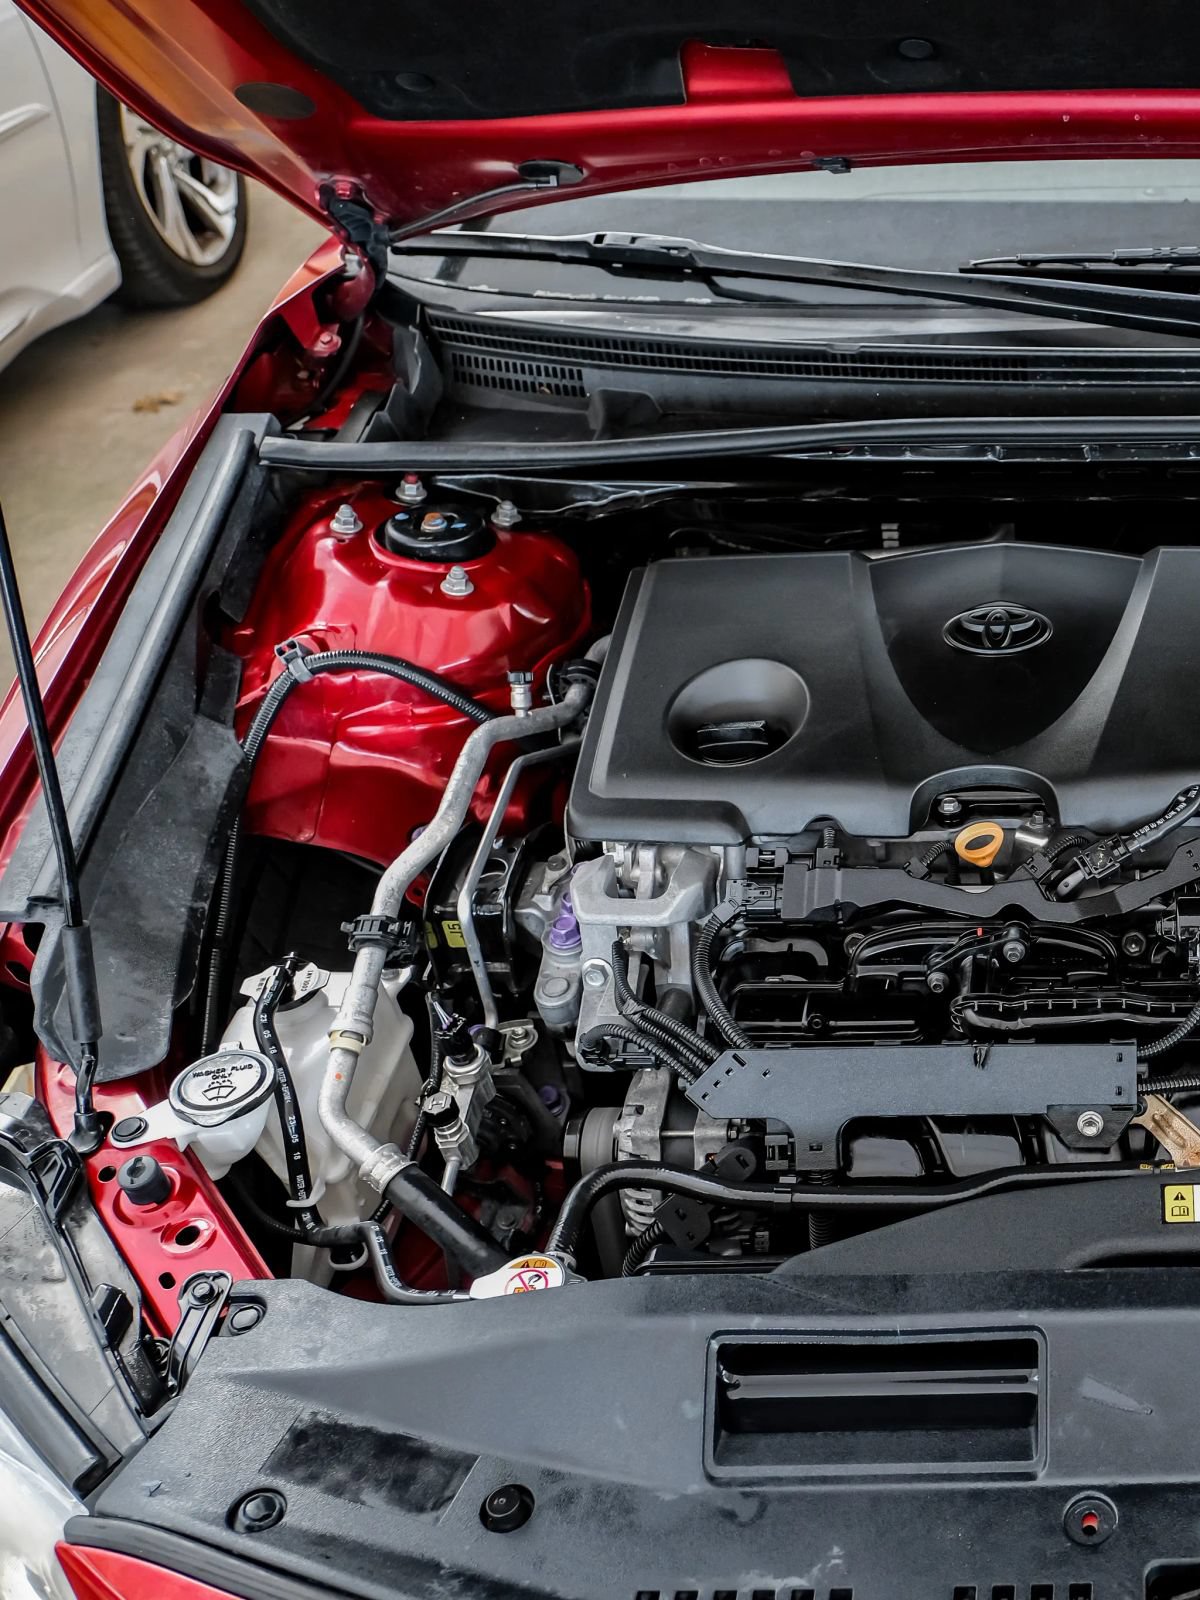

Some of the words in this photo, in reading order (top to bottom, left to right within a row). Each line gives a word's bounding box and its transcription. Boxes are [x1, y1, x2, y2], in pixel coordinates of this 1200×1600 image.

[192, 1067, 226, 1078] WASHER
[231, 1063, 254, 1072] FLUID
[211, 1072, 233, 1080] ONLY
[428, 1095, 448, 1111] H
